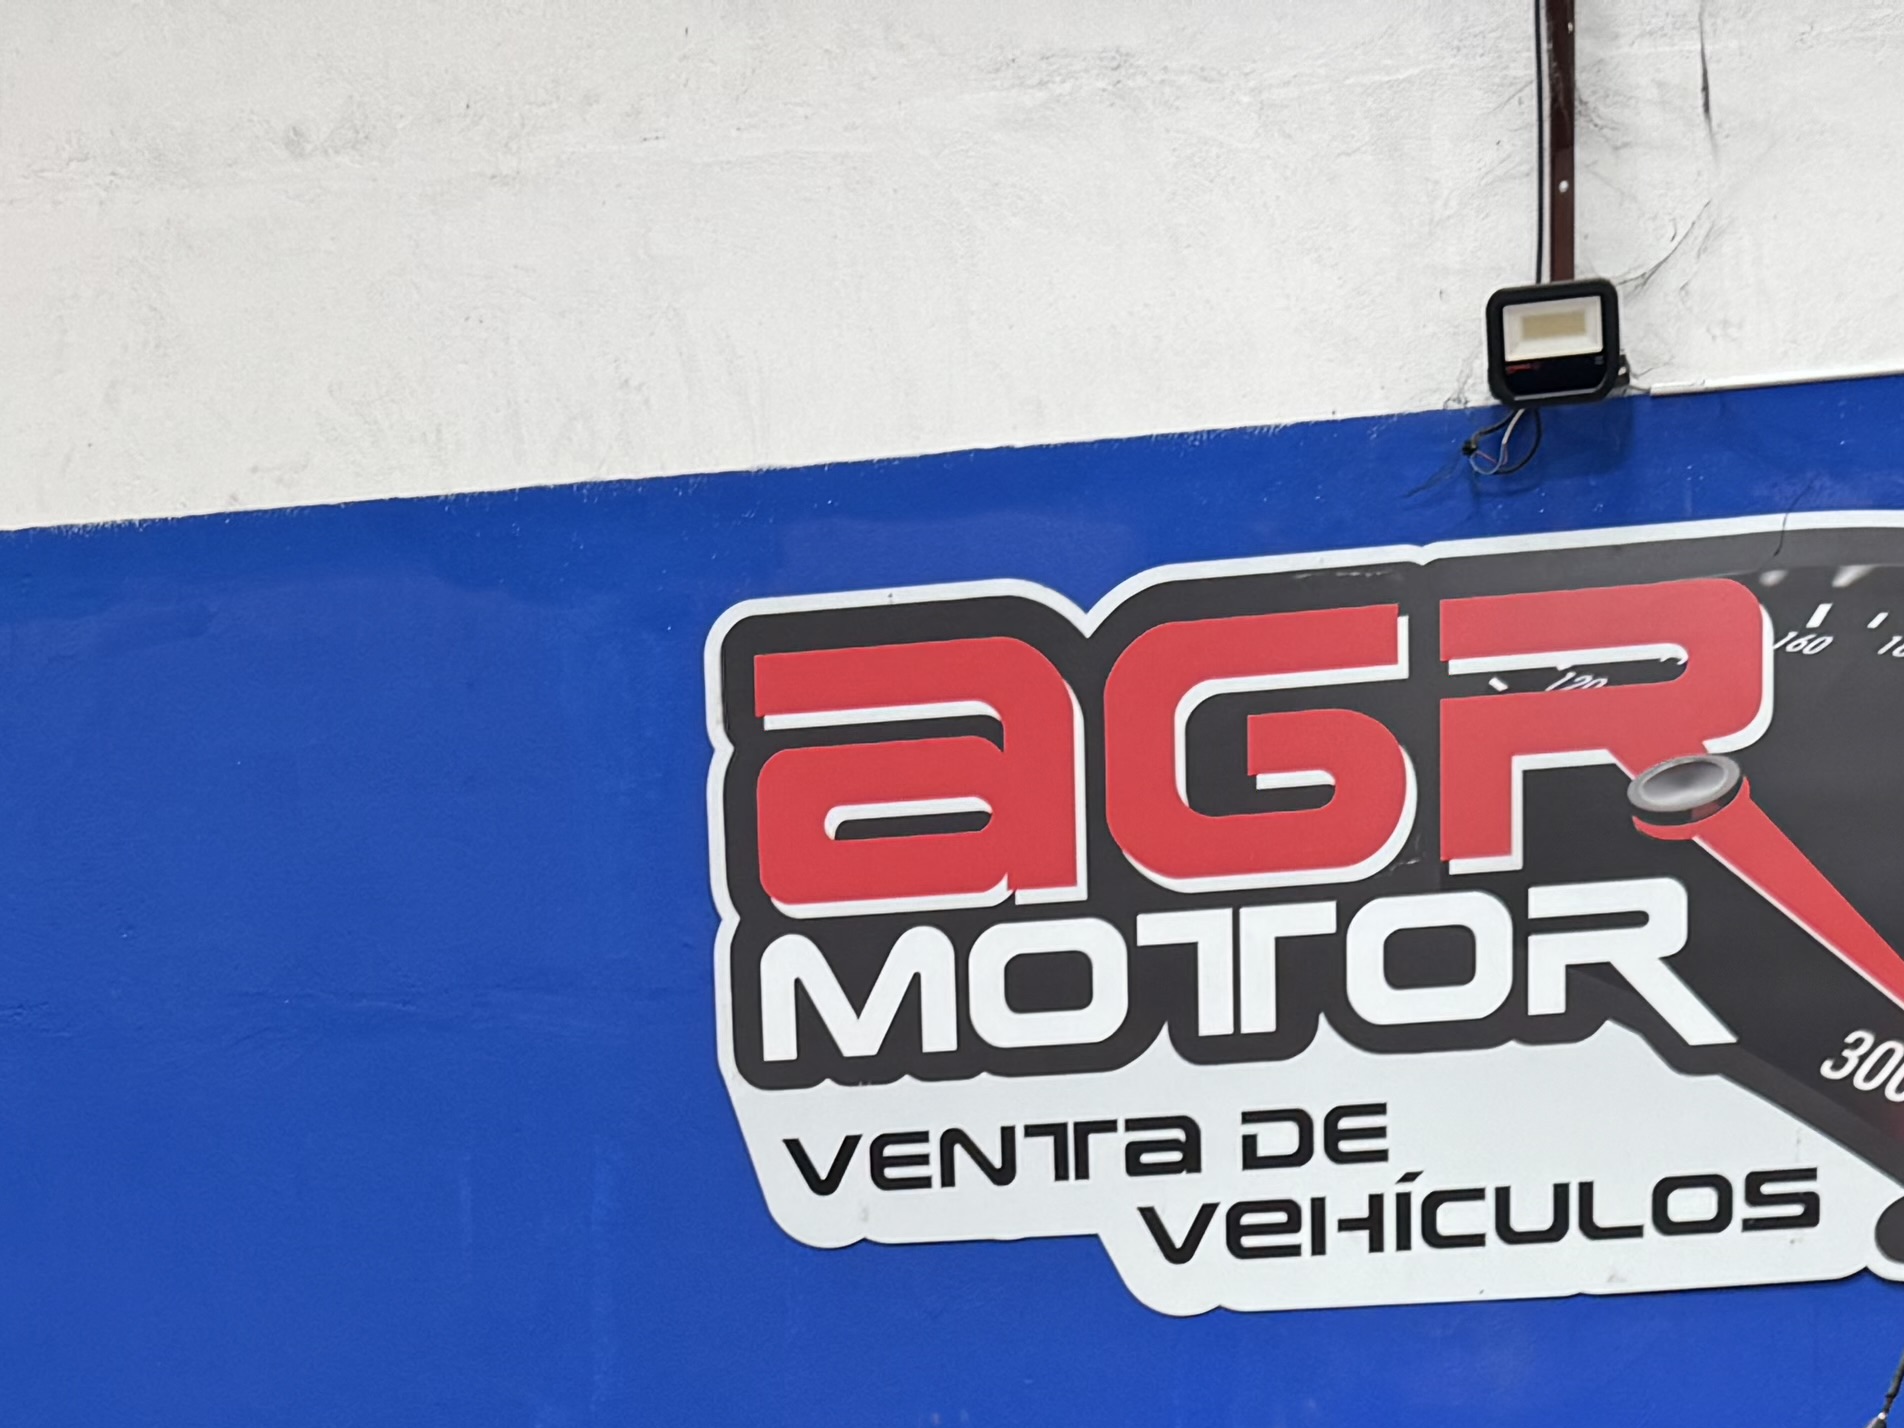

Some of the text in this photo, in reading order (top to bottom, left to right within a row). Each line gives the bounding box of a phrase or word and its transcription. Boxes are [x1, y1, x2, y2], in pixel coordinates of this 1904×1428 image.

[1772, 631, 1834, 655] 160
[758, 875, 1739, 1064] MOTOR
[1239, 1100, 1390, 1172] DE
